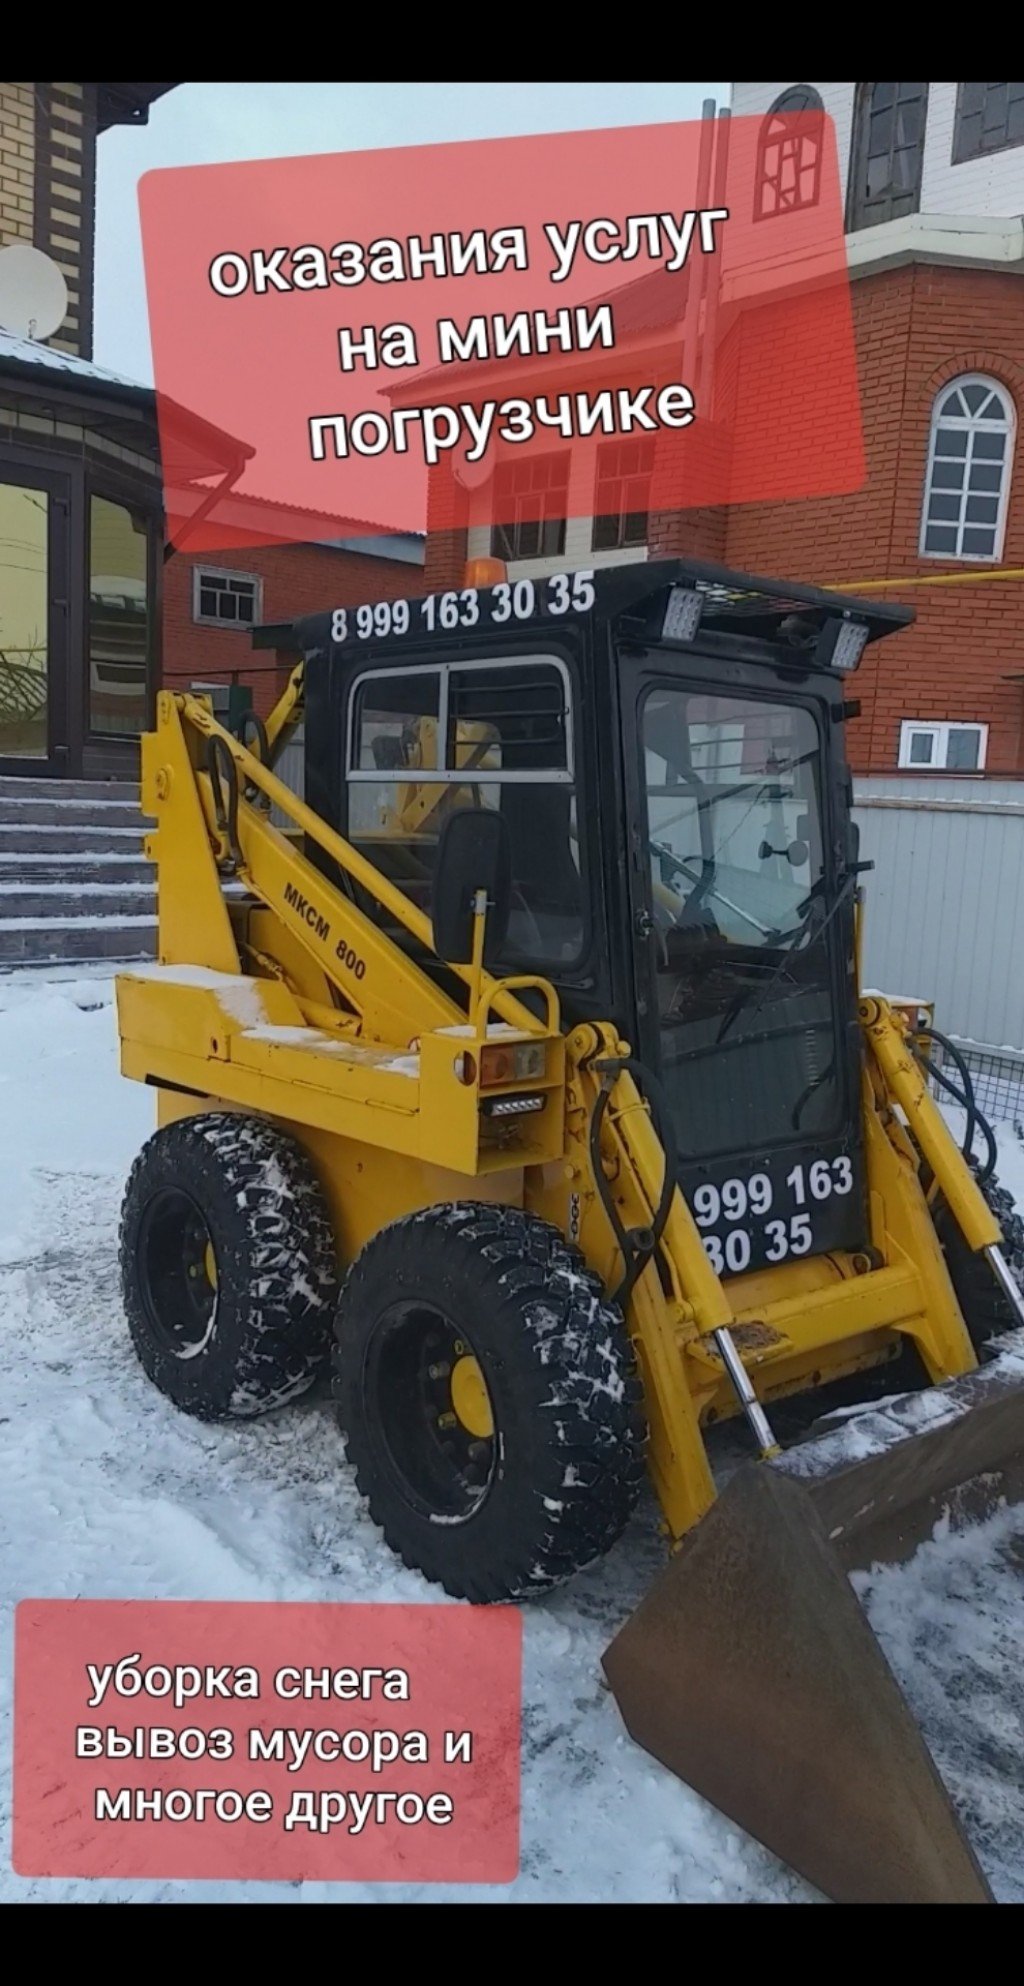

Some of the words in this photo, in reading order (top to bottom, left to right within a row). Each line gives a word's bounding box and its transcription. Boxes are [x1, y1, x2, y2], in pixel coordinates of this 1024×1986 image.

[331, 608, 348, 642] 8
[356, 599, 410, 639] 999
[421, 588, 480, 631] 163
[491, 579, 535, 622] 30
[548, 569, 596, 615] 35
[284, 882, 331, 942] МКСМ
[336, 939, 366, 980] 800
[694, 1173, 773, 1227] 999
[787, 1156, 853, 1204] 163
[765, 1213, 812, 1261] 35
